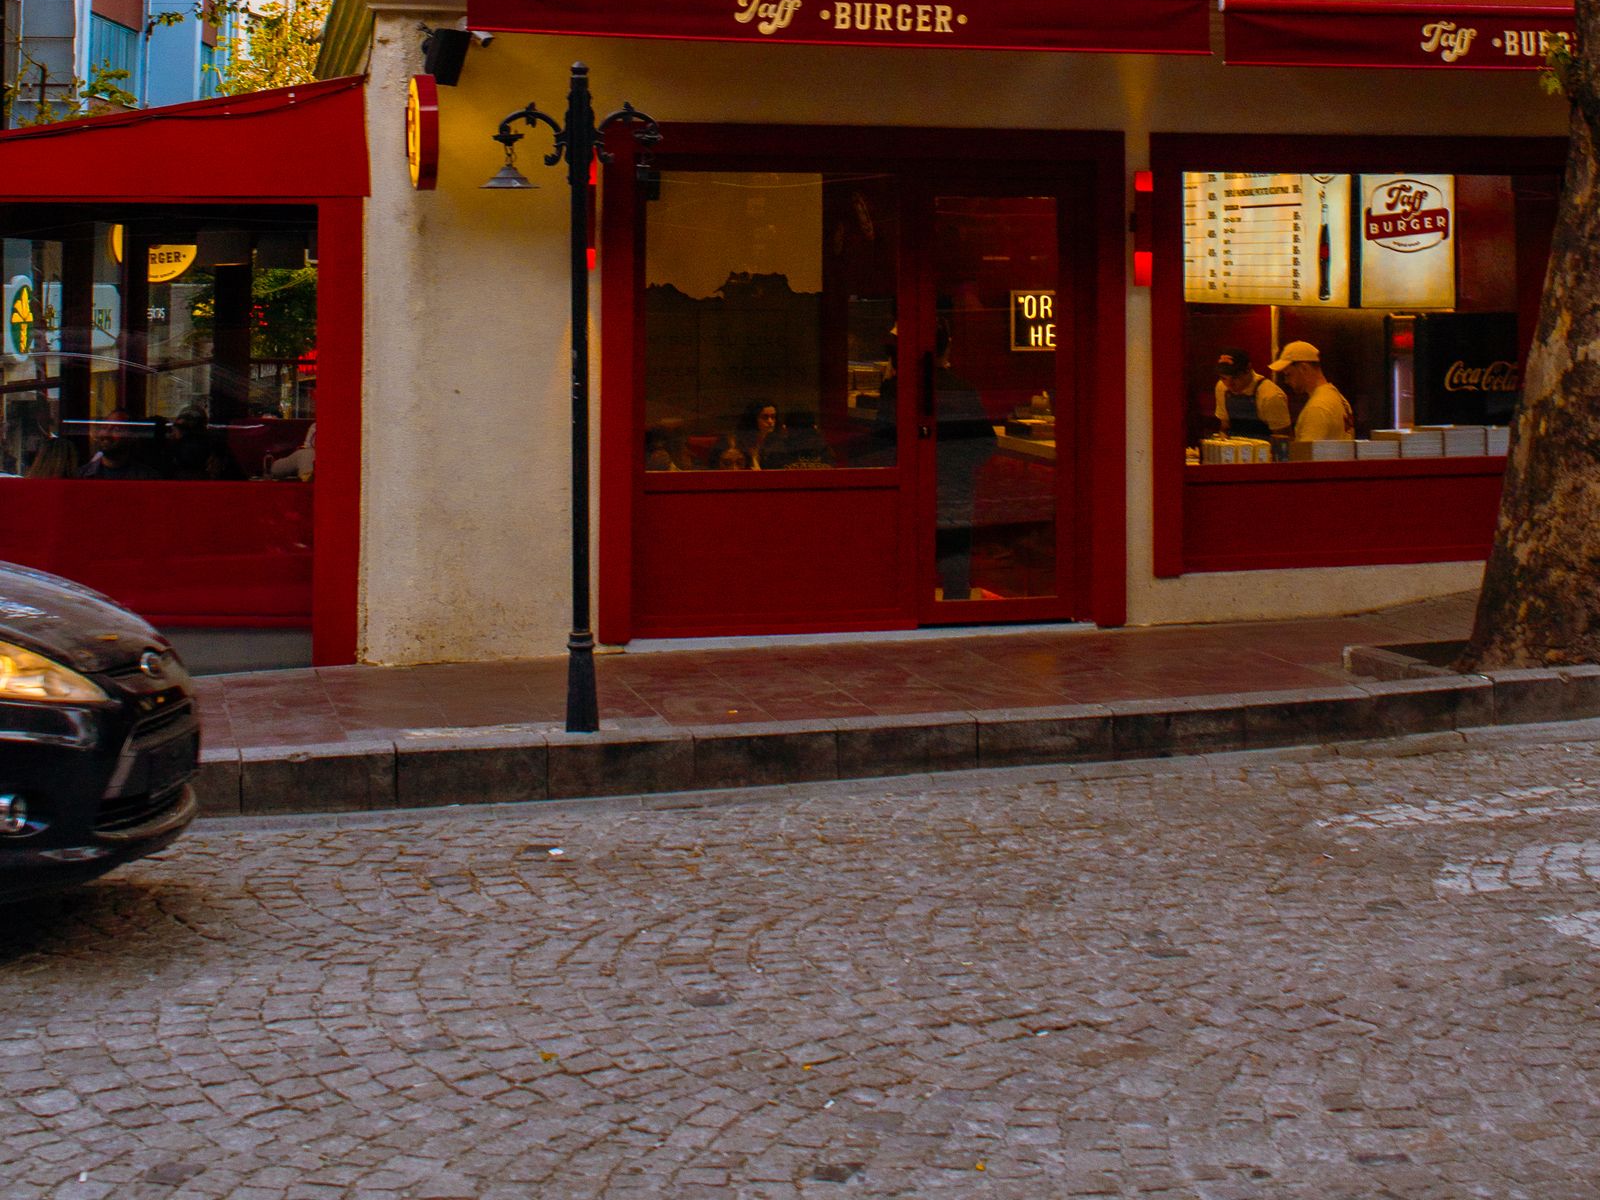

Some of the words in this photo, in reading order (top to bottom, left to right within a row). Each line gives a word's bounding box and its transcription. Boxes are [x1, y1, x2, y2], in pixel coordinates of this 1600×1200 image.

[834, 1, 954, 33] BURGER
[1420, 20, 1478, 63] Taff
[1385, 184, 1429, 221] Taff
[1369, 215, 1447, 235] BURGER
